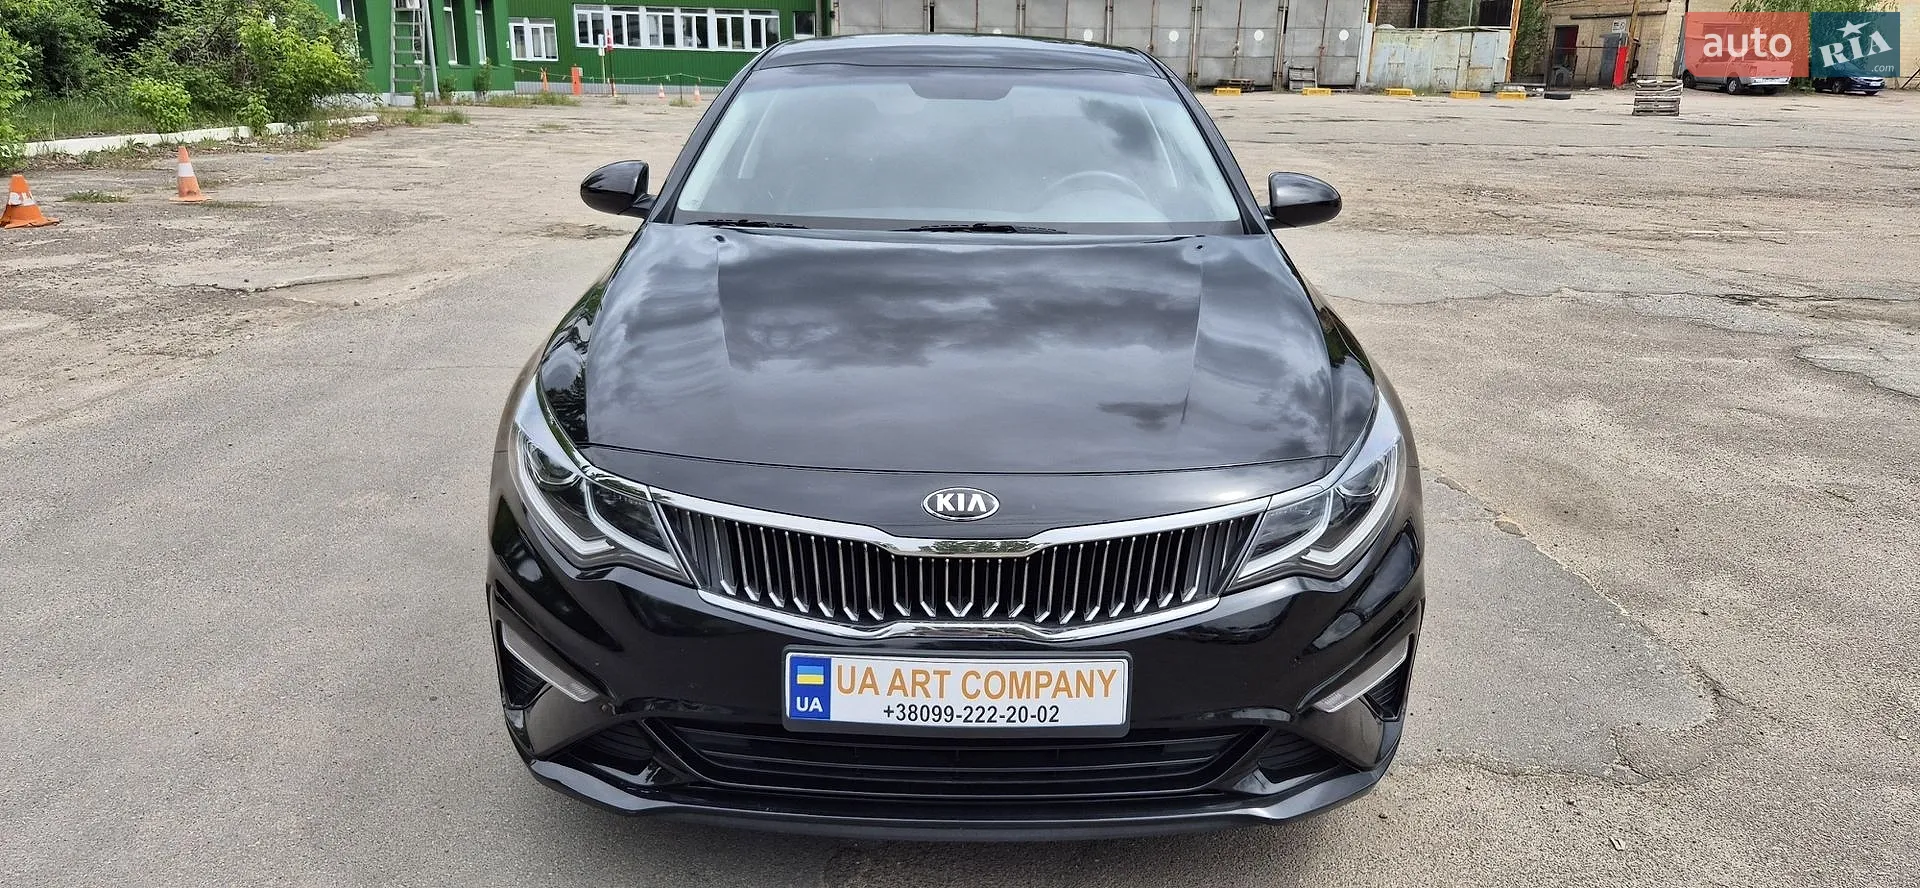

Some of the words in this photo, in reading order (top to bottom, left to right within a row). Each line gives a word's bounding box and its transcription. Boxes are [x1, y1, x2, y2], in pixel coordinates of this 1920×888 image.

[936, 493, 987, 512] KIA
[836, 665, 880, 696] UA
[886, 667, 951, 699] ART
[960, 669, 1118, 700] COMPANY
[796, 697, 823, 713] UA
[883, 704, 1060, 723] +38099-222-20-02
